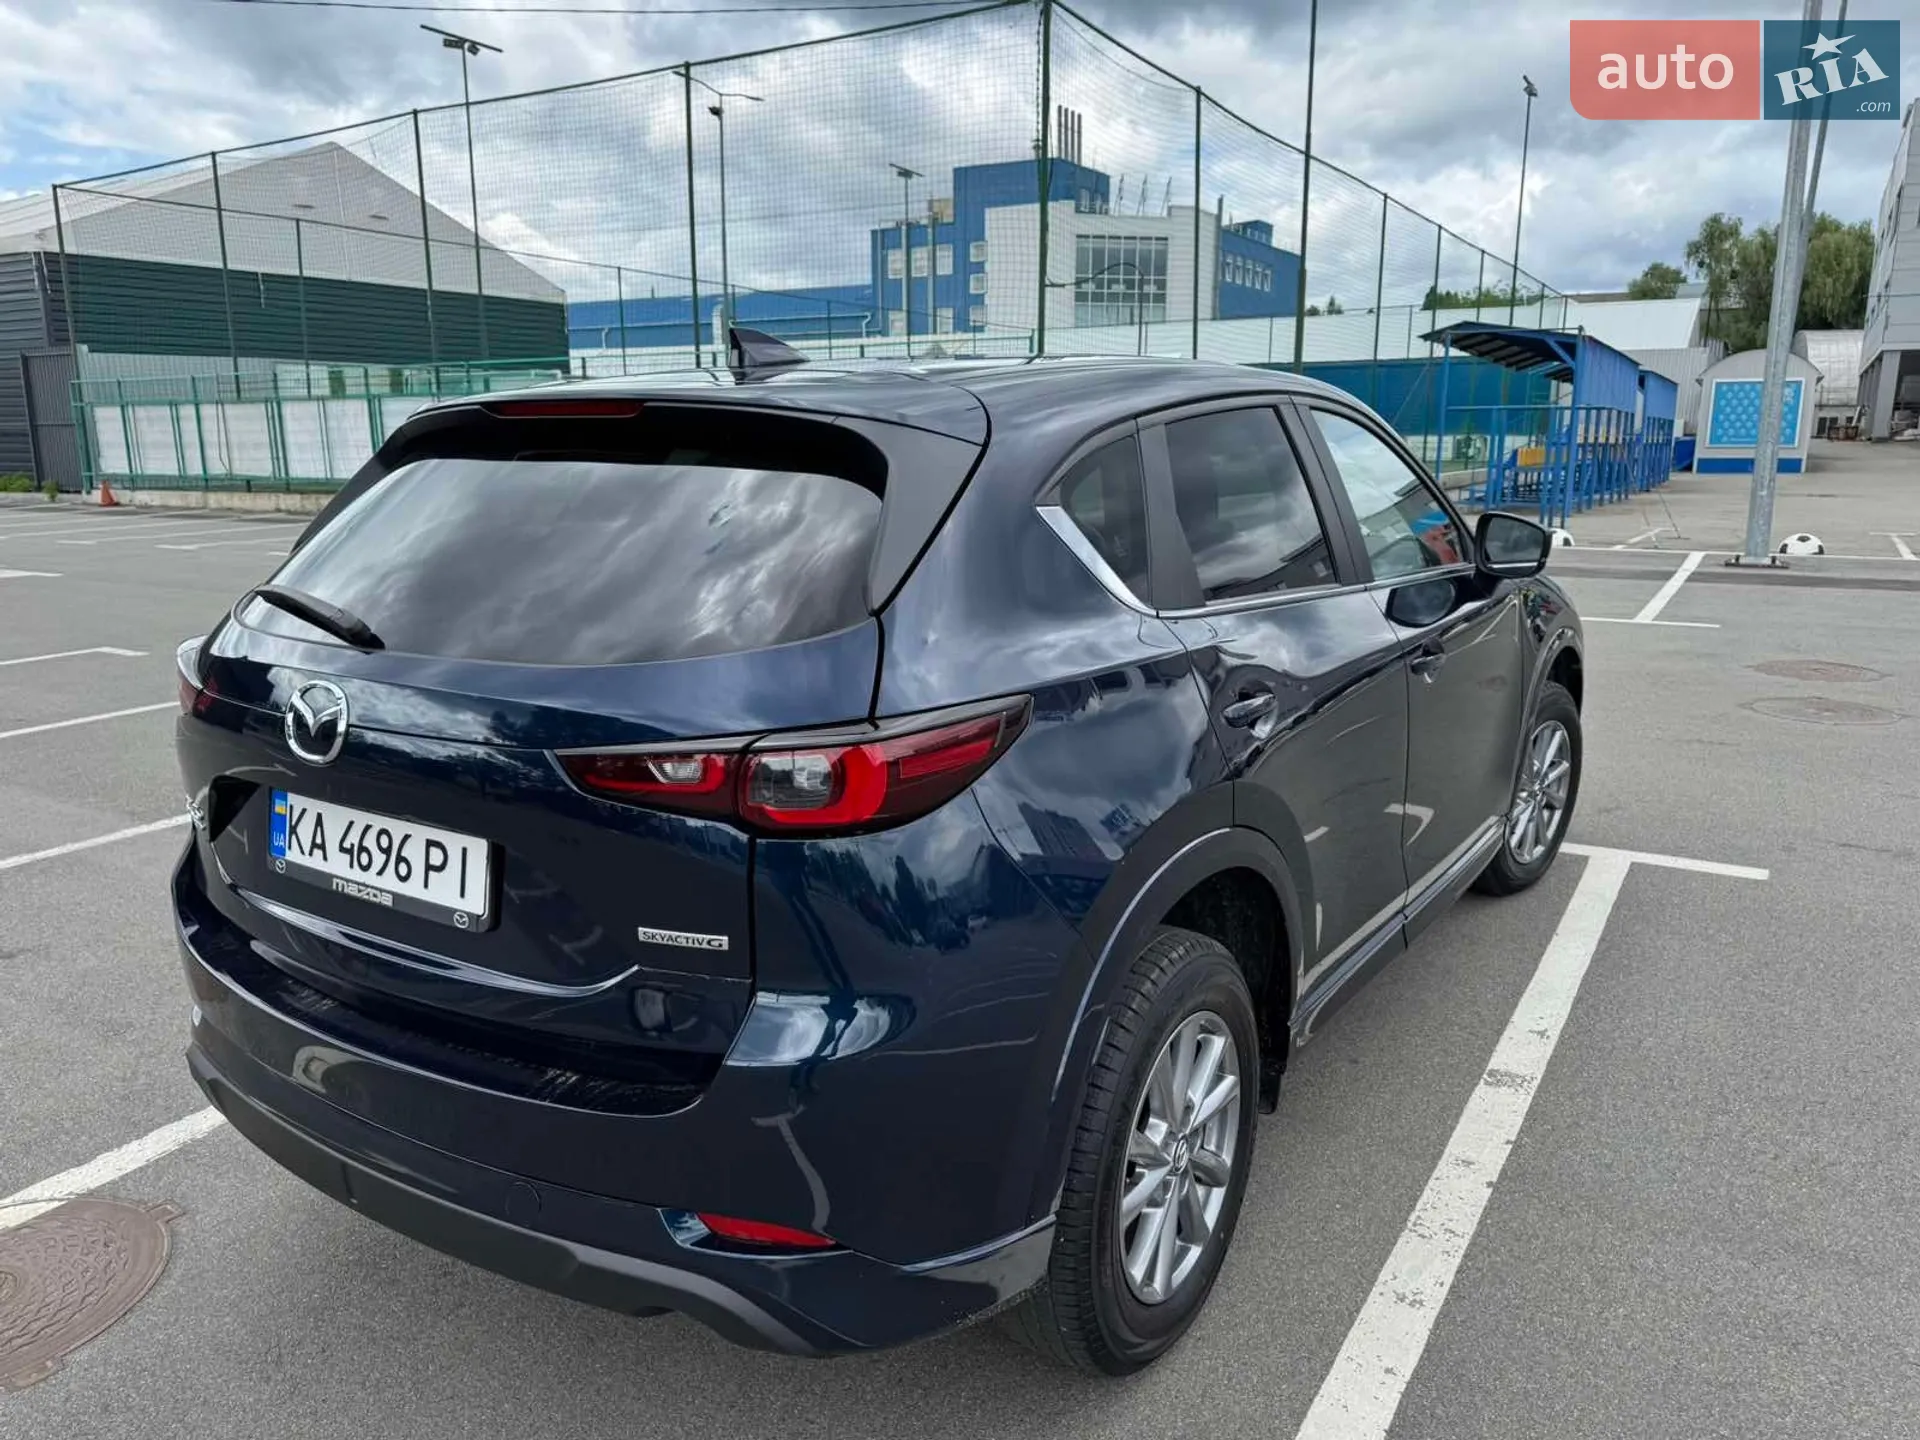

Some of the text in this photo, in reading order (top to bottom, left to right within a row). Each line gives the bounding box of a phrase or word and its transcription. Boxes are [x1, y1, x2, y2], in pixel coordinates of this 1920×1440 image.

[273, 831, 285, 849] UA
[287, 804, 468, 899] KA 4696 PI
